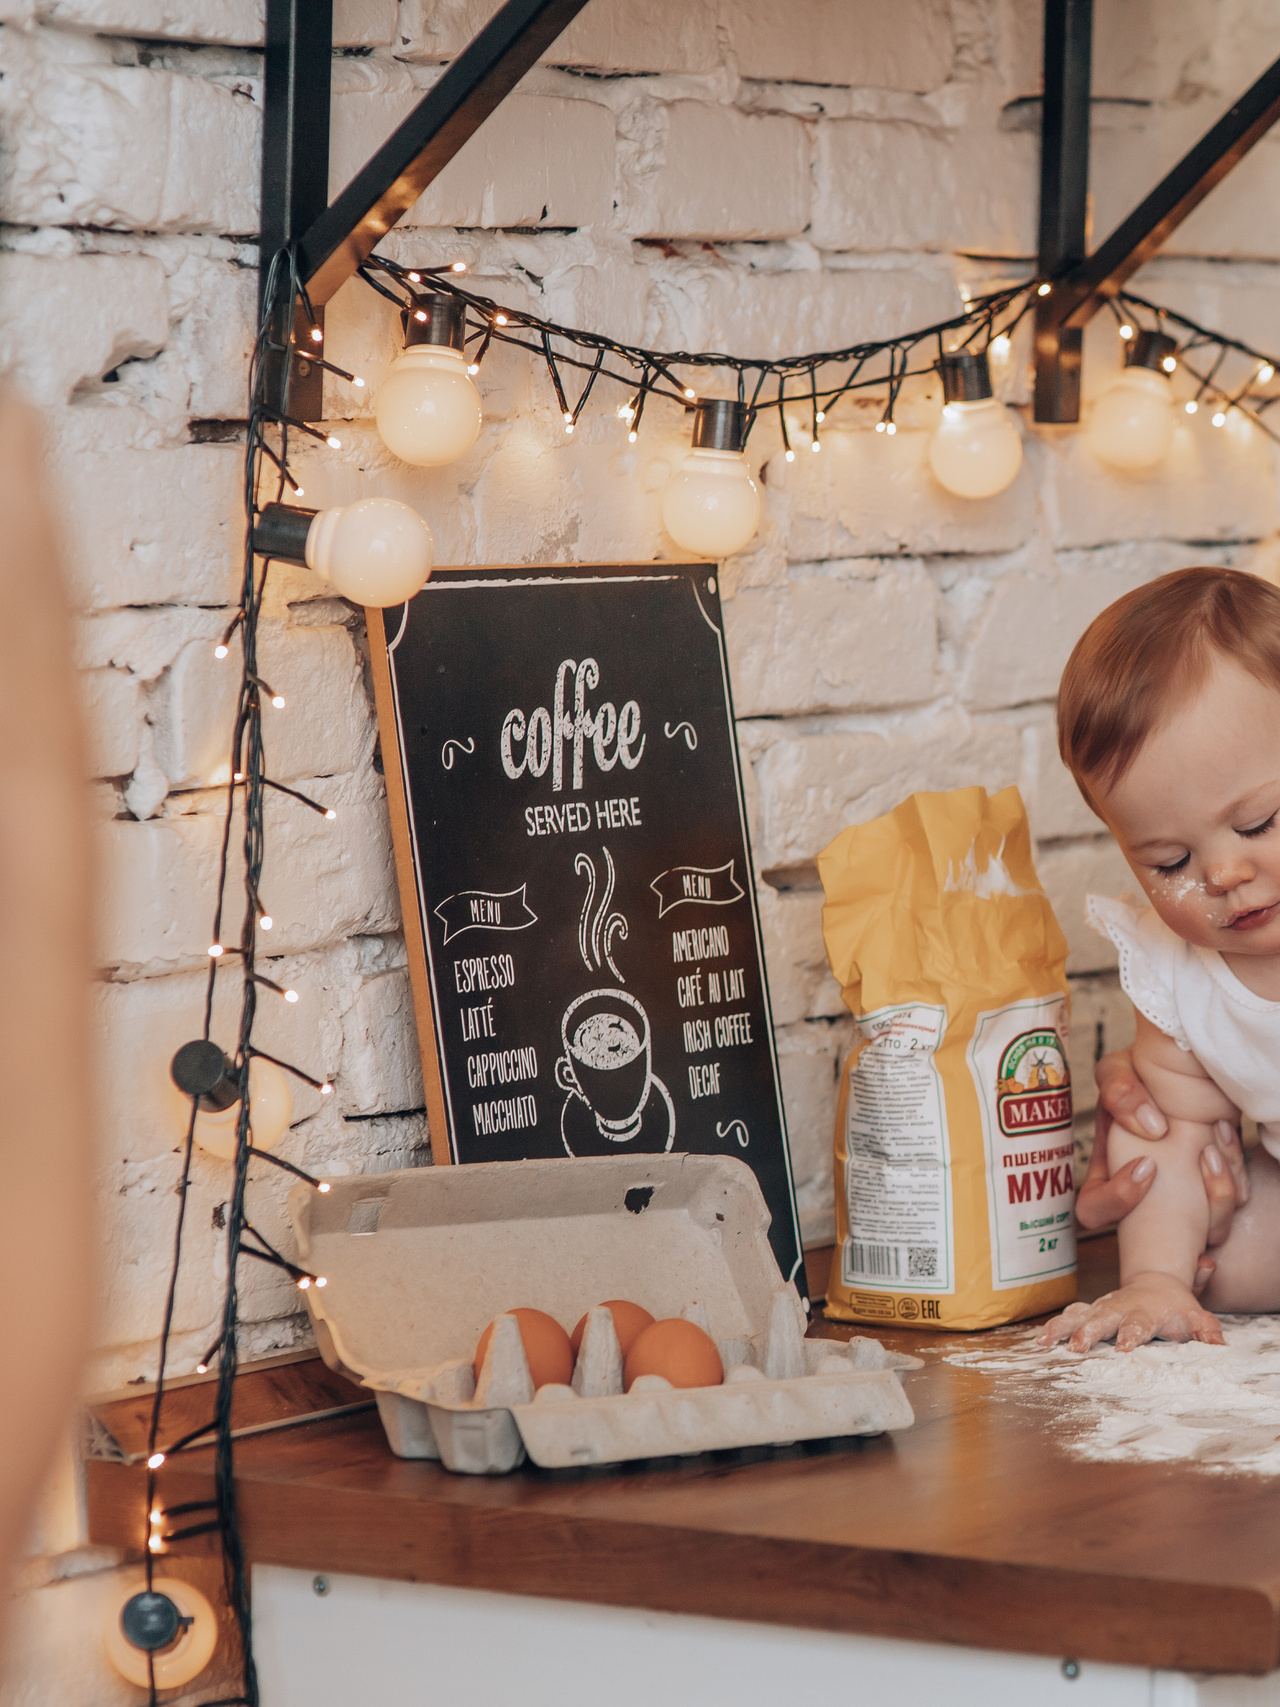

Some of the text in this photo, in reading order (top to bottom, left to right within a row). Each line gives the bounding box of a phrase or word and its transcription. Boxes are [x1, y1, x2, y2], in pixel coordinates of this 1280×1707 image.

[501, 657, 646, 791] coffee
[525, 797, 642, 837] SERVED HERE
[682, 874, 712, 900] MENU
[470, 899, 502, 925] MENU
[672, 926, 730, 963] AMERICANO
[454, 954, 515, 994] ESPRESSO
[677, 967, 746, 1008] CAFÉ AU LAIT
[460, 997, 497, 1042] LATTÉ
[682, 1012, 754, 1054] IRISH COFFEE
[467, 1046, 538, 1089] CAPPUCCINO
[688, 1062, 722, 1100] DECAF
[472, 1095, 537, 1136] MACCHIATO
[1007, 1163, 1073, 1204] МУКА
[1039, 1237, 1045, 1252] 2
